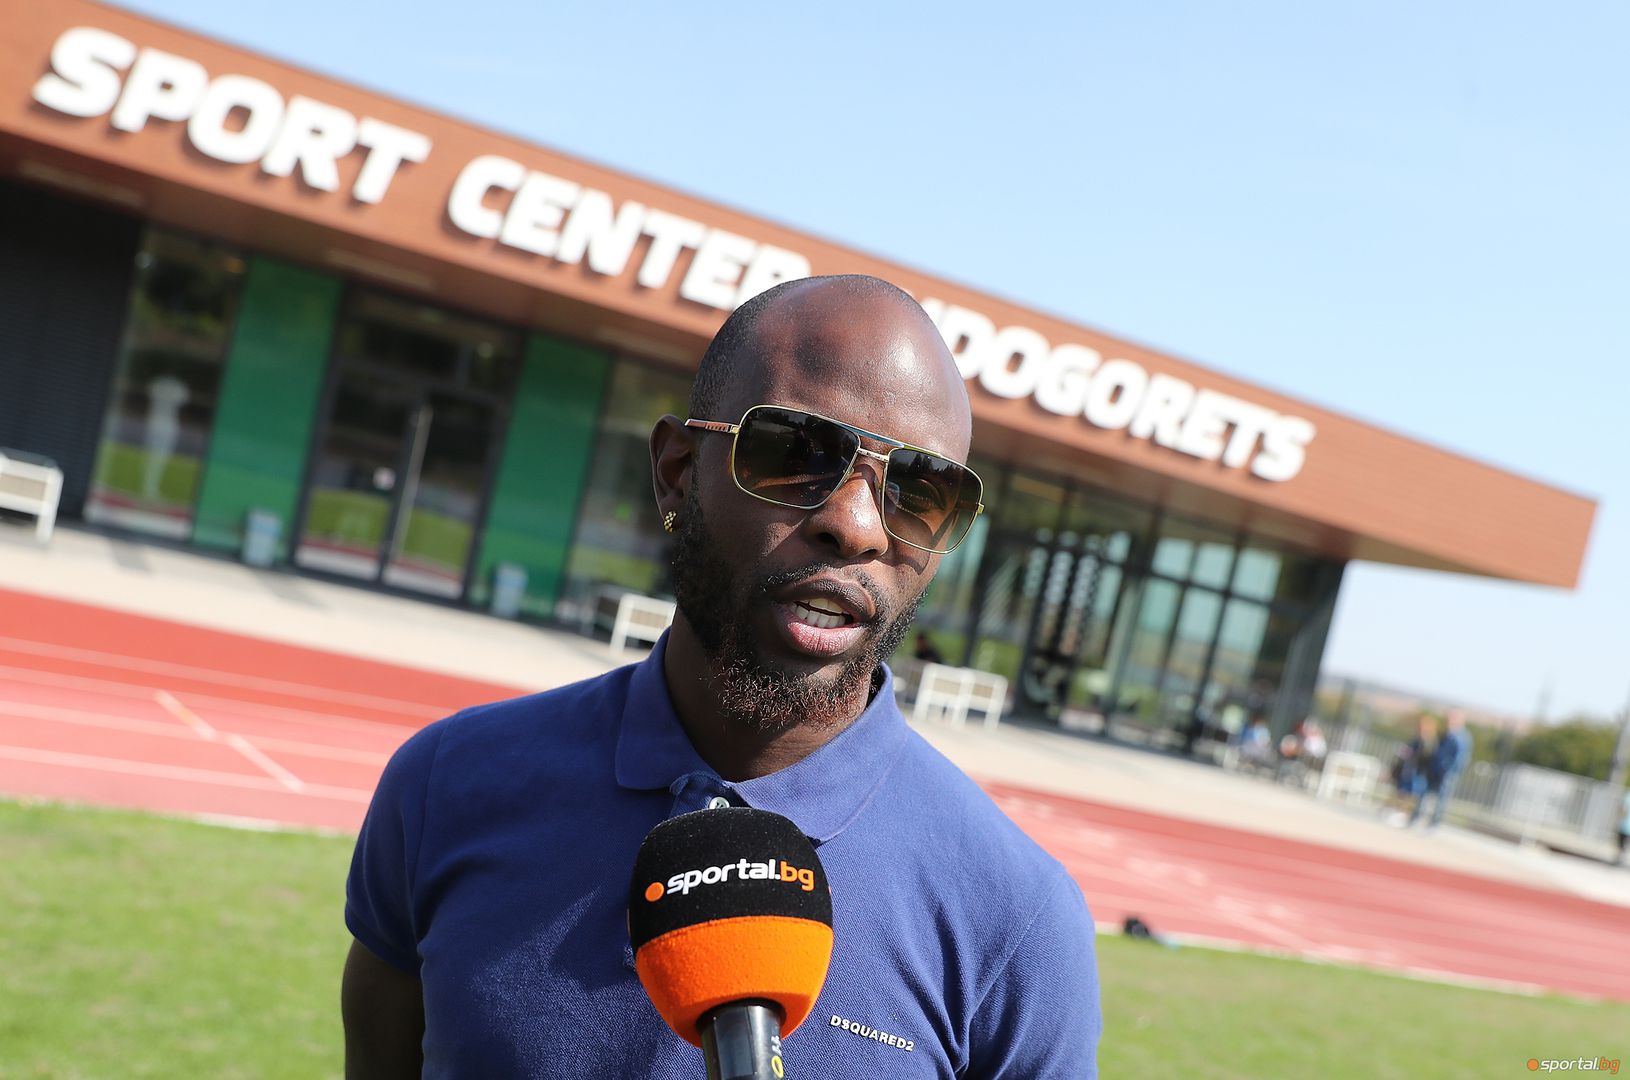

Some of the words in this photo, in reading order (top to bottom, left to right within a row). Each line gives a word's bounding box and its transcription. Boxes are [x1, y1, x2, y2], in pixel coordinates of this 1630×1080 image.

[32, 26, 432, 205] SPORT
[666, 858, 815, 895] sportal.bg
[829, 1014, 915, 1052] DSQUARED2
